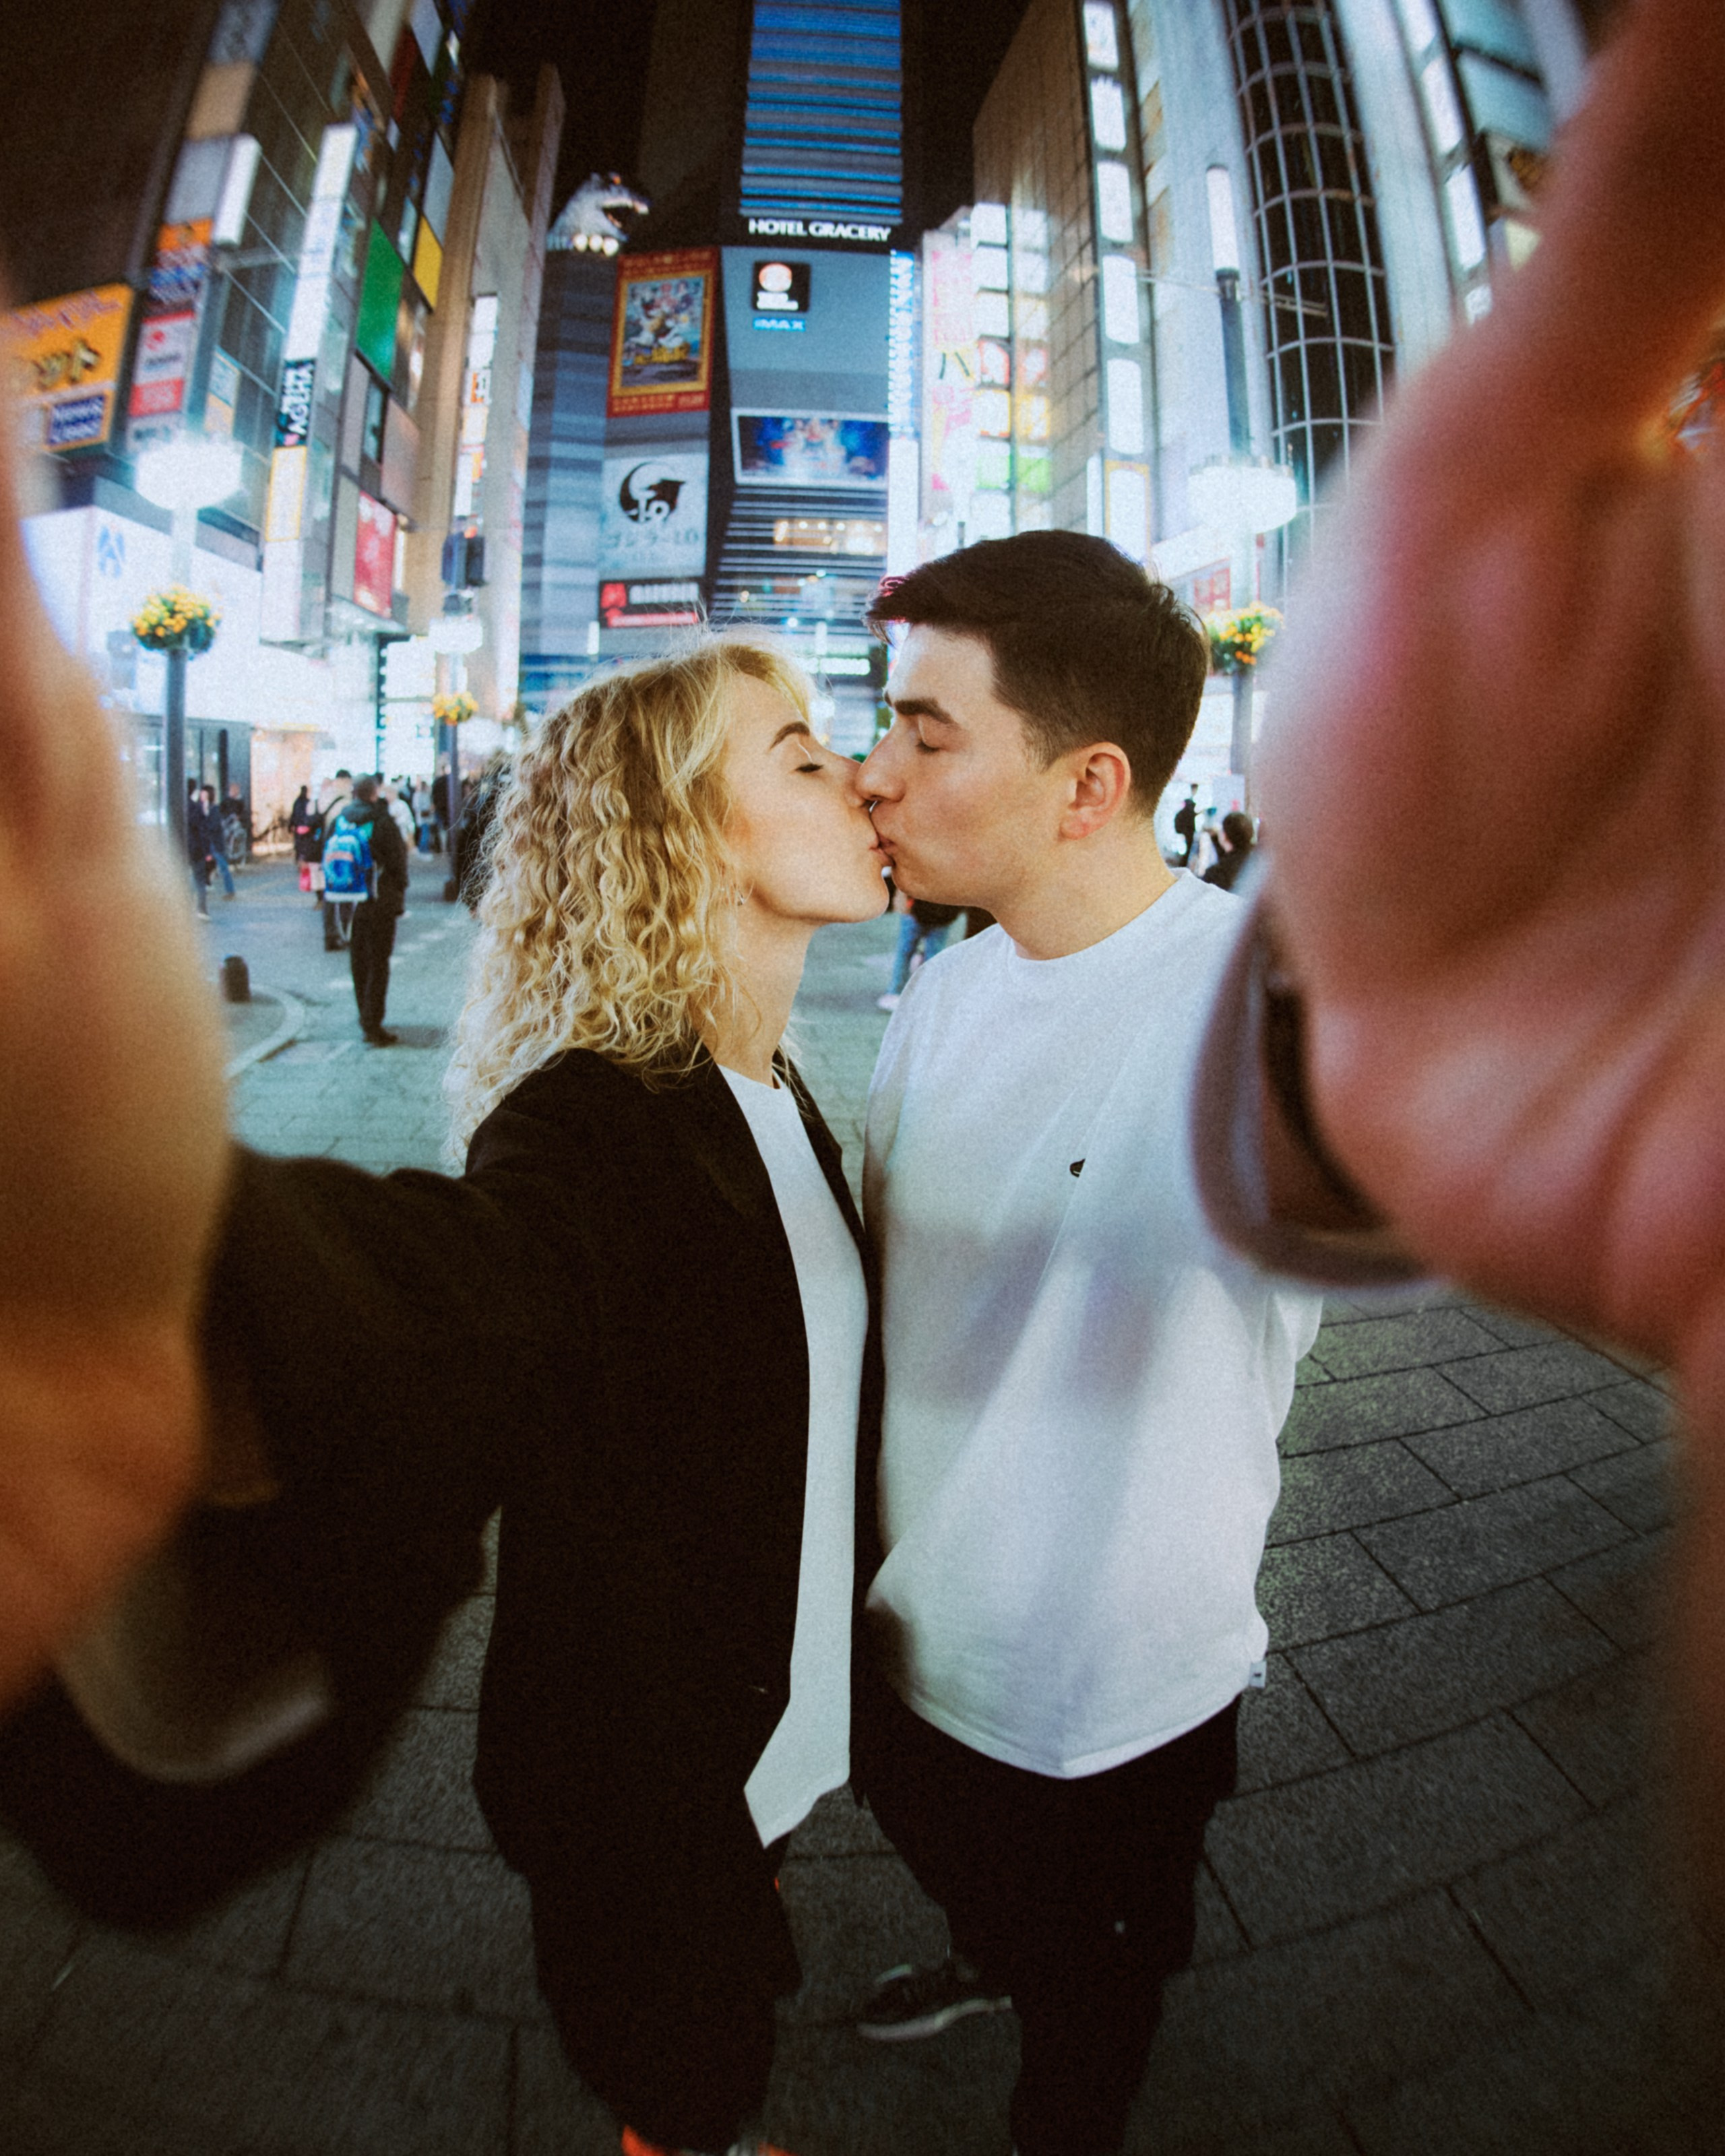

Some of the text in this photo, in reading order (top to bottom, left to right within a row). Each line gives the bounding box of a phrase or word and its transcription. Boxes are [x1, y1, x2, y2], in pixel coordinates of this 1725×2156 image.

[748, 218, 891, 242] HOTEL GRACERY
[753, 318, 805, 331] IMAX
